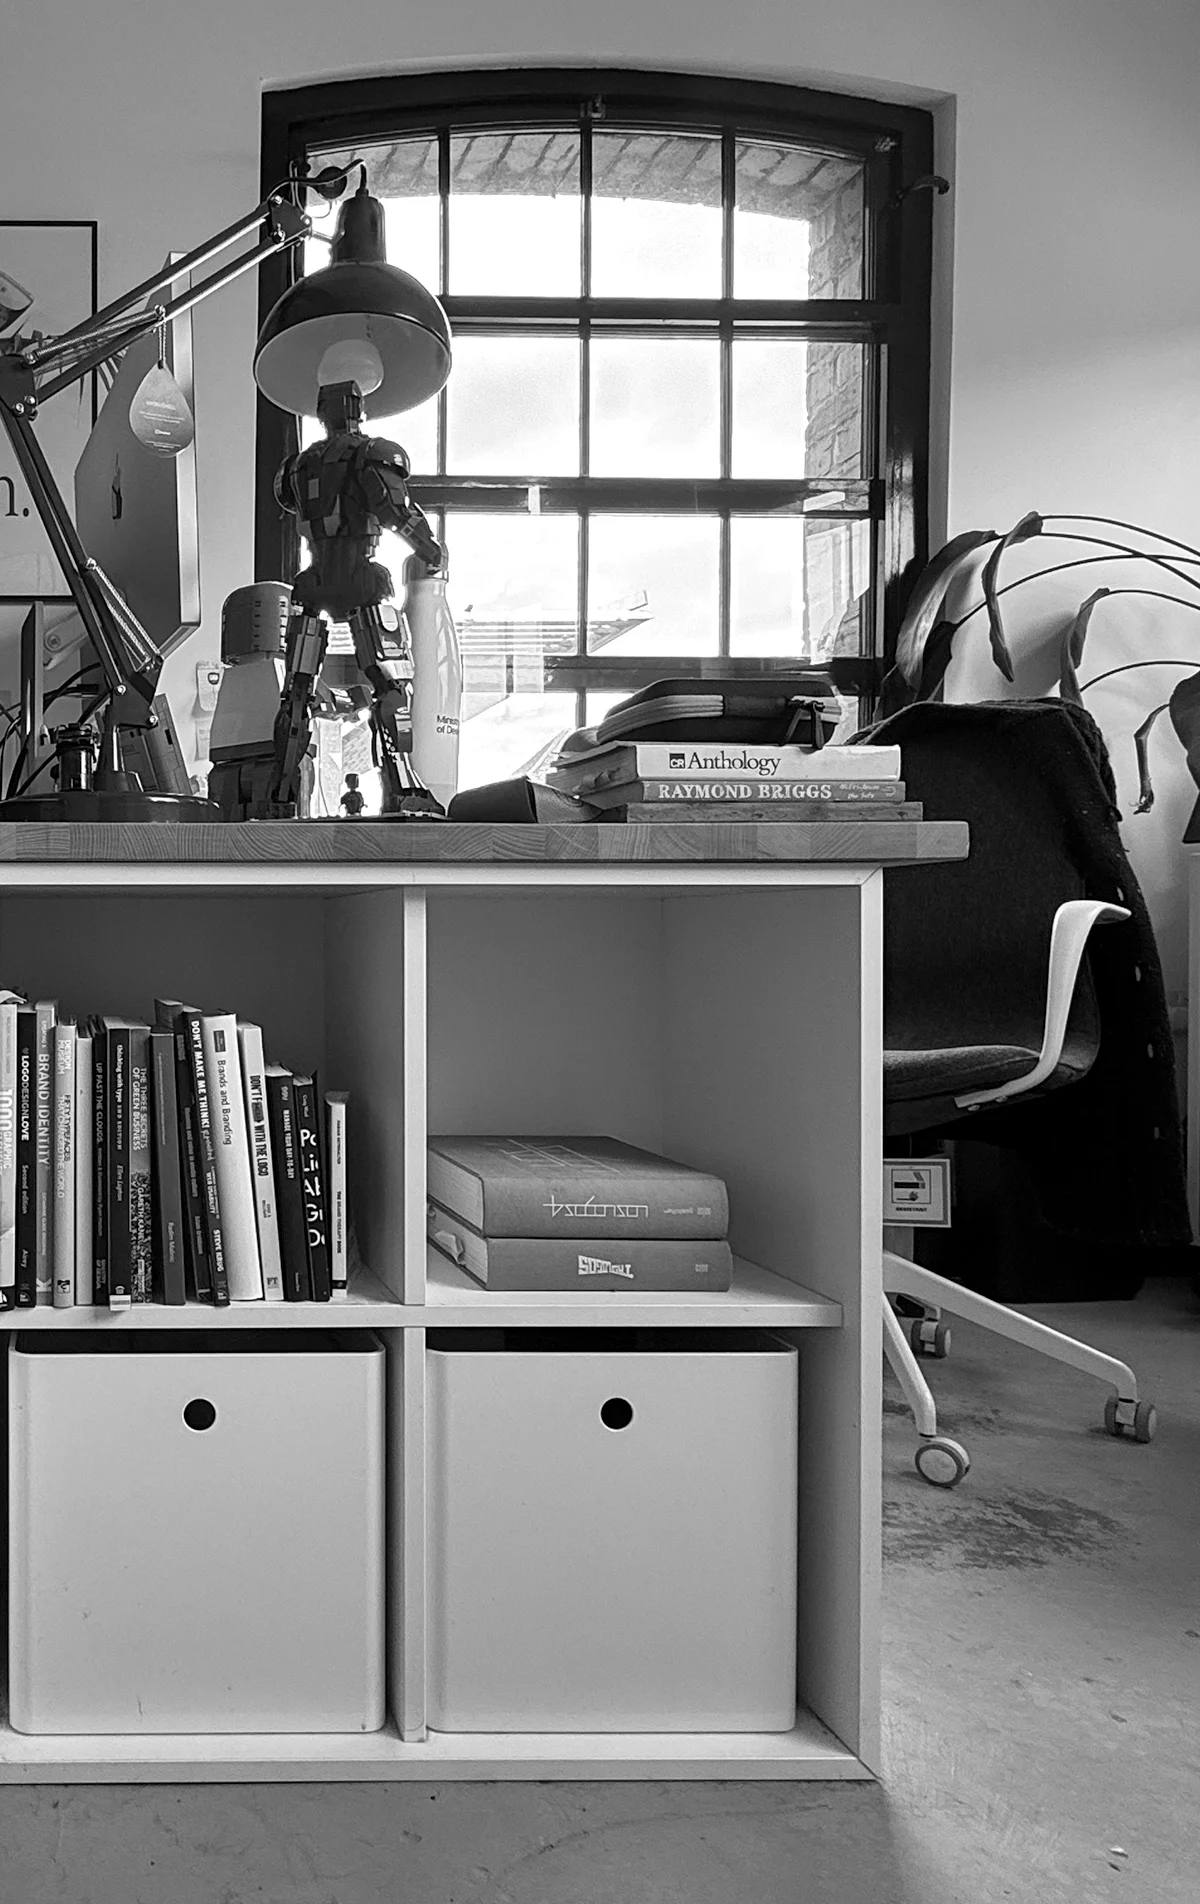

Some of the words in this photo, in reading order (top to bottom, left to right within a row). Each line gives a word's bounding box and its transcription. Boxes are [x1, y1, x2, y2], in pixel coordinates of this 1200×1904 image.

[670, 757, 685, 768] CR
[686, 749, 782, 777] Anthology
[657, 783, 753, 800] RAYMOND
[757, 783, 833, 800] BRIGGS
[190, 1020, 202, 1049] DON'T
[57, 1039, 65, 1075] MUSEUM
[64, 1039, 72, 1071] DESIGN
[96, 1062, 103, 1073] UP
[194, 1051, 206, 1077] MAKE
[38, 1053, 51, 1101] BRAND
[132, 1066, 140, 1079] OF
[140, 1067, 148, 1083] THE
[217, 1059, 229, 1088] Brands
[249, 1074, 263, 1097] DON'T
[115, 1088, 123, 1103] type
[132, 1080, 141, 1110] GREEN
[140, 1085, 148, 1111] THREE
[197, 1079, 207, 1094] ME
[220, 1090, 230, 1106] and
[57, 1095, 65, 1114] THAT
[63, 1094, 72, 1116] FIFTY
[198, 1096, 211, 1128] THINK!
[57, 1114, 65, 1152] CHANGED
[132, 1111, 141, 1151] BUSINESS
[140, 1113, 148, 1149] SECRETS
[222, 1108, 233, 1146] Branding
[253, 1124, 267, 1142] WITH
[283, 1109, 292, 1132] MANAGE
[38, 1104, 51, 1165] IDENTITY
[62, 1117, 72, 1163] TYPEFACES
[284, 1133, 293, 1147] YOUR
[3, 1130, 13, 1169] GRAPHIC
[57, 1152, 65, 1169] THE
[255, 1143, 268, 1157] THE
[256, 1157, 269, 1177] LOGO
[286, 1147, 295, 1179] DAY-TO-DAY
[22, 1163, 30, 1190] Second
[57, 1169, 65, 1198] WORLD
[21, 1190, 30, 1215] edition
[137, 1187, 145, 1217] GARETH
[213, 1229, 223, 1251] STEVE
[20, 1248, 30, 1268] Airey
[215, 1251, 225, 1272] KRUG
